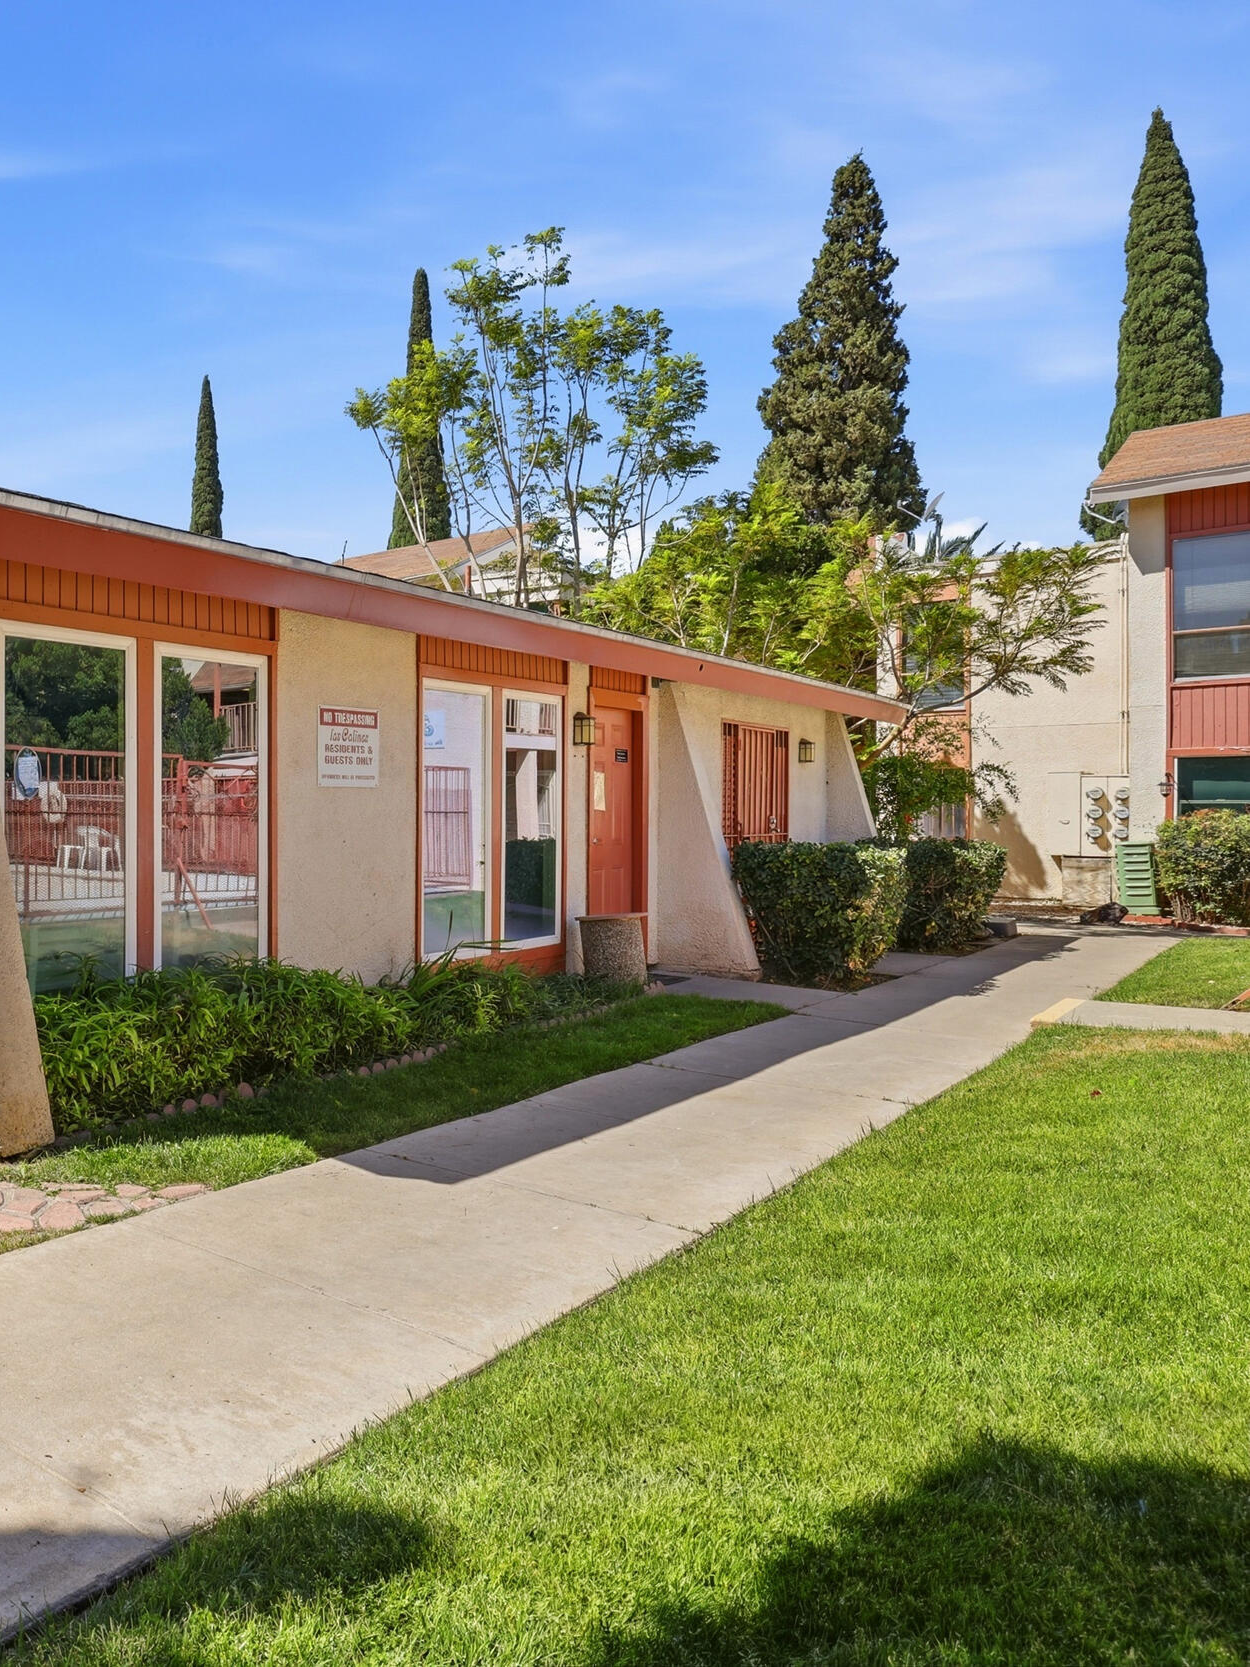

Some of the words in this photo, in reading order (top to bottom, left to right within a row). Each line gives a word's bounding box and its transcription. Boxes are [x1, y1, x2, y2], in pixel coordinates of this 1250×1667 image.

[323, 711, 333, 723] NO
[334, 712, 375, 726] TRESPASSING
[324, 744, 366, 754] RESIDENTS
[367, 746, 373, 755] &
[324, 755, 354, 765] GUESTS
[355, 757, 373, 766] ONLY
